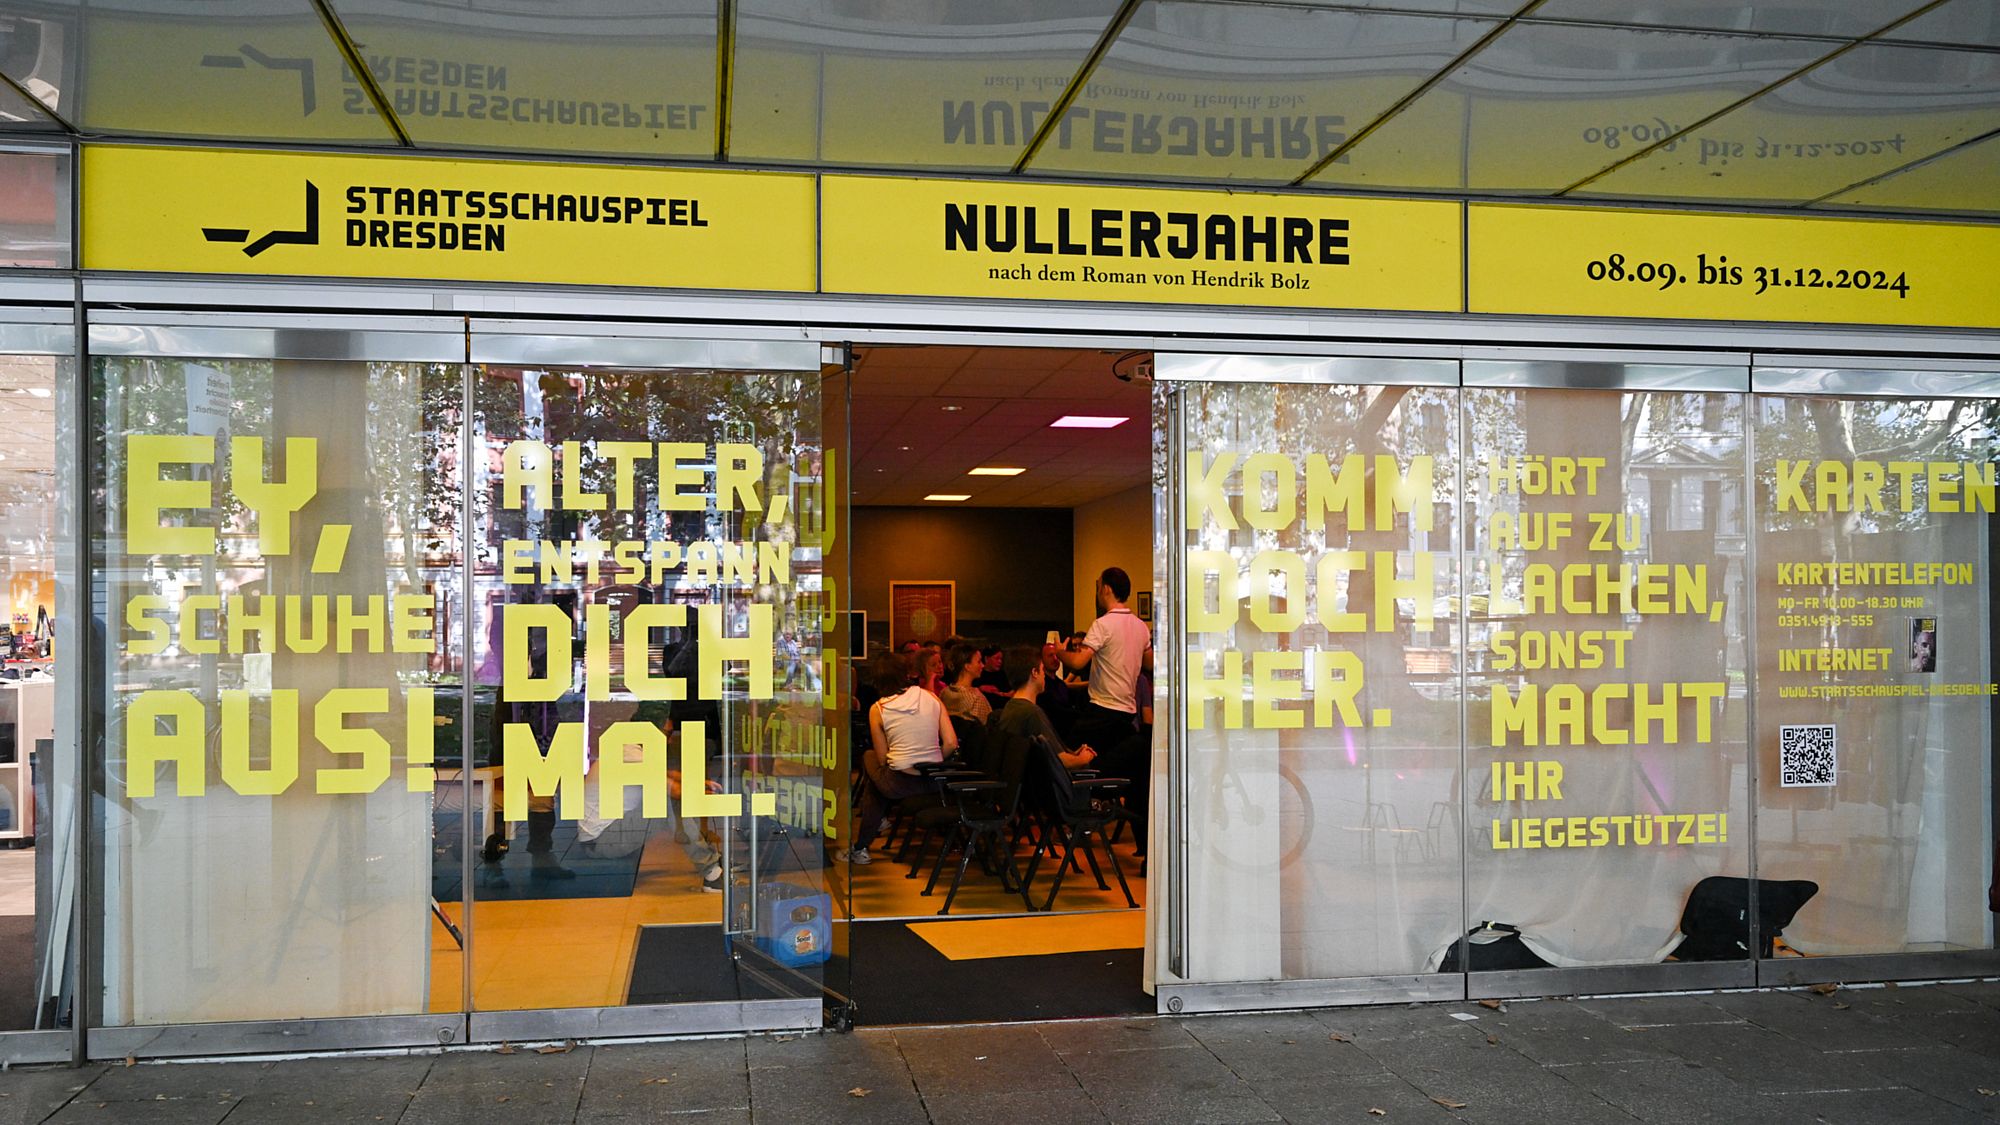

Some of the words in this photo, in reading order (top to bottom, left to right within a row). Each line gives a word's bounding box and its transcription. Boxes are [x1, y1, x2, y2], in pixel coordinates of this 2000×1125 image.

[346, 186, 708, 227] STAATSSCHAUSPIEL
[346, 219, 505, 252] DRESDEN
[945, 203, 1350, 266] NULLERJAHRE
[988, 263, 1031, 280] nach
[1037, 264, 1076, 282] dem
[1082, 266, 1147, 284] Roman
[1152, 274, 1186, 286] von
[1191, 269, 1265, 288] Hendrik
[1271, 272, 1310, 290] Bolz
[1586, 253, 1687, 291] 08.09.
[1697, 254, 1743, 286] bis
[1754, 266, 1911, 299] 31.12.2024
[503, 440, 788, 524] ALTER,
[1187, 451, 1433, 532] KOMM
[1490, 456, 1606, 496] HÖRT
[1775, 459, 1996, 513] KARTEN
[127, 434, 352, 574] EY,
[1491, 512, 1573, 551] AUF
[1587, 513, 1641, 552] ZU
[503, 540, 789, 585] ENTSPANN
[1777, 562, 1973, 585] KARTENTELEFON
[1187, 550, 1434, 634] DOCH
[1490, 563, 1724, 623] LACHEN,
[1778, 597, 1820, 609] MO-FR
[1901, 597, 1924, 609] UHR
[126, 594, 435, 655] SCHUHE
[503, 603, 773, 702] DICH
[1491, 630, 1633, 670] SONST
[1779, 647, 1893, 672] INTERNET
[1187, 651, 1392, 730] HER.
[1491, 682, 1726, 747] MACHT
[126, 688, 435, 798] AUS!
[503, 720, 776, 822] MAL.
[1492, 761, 1563, 801] IHR
[1492, 813, 1728, 850] LIEGESTÜTZE!
